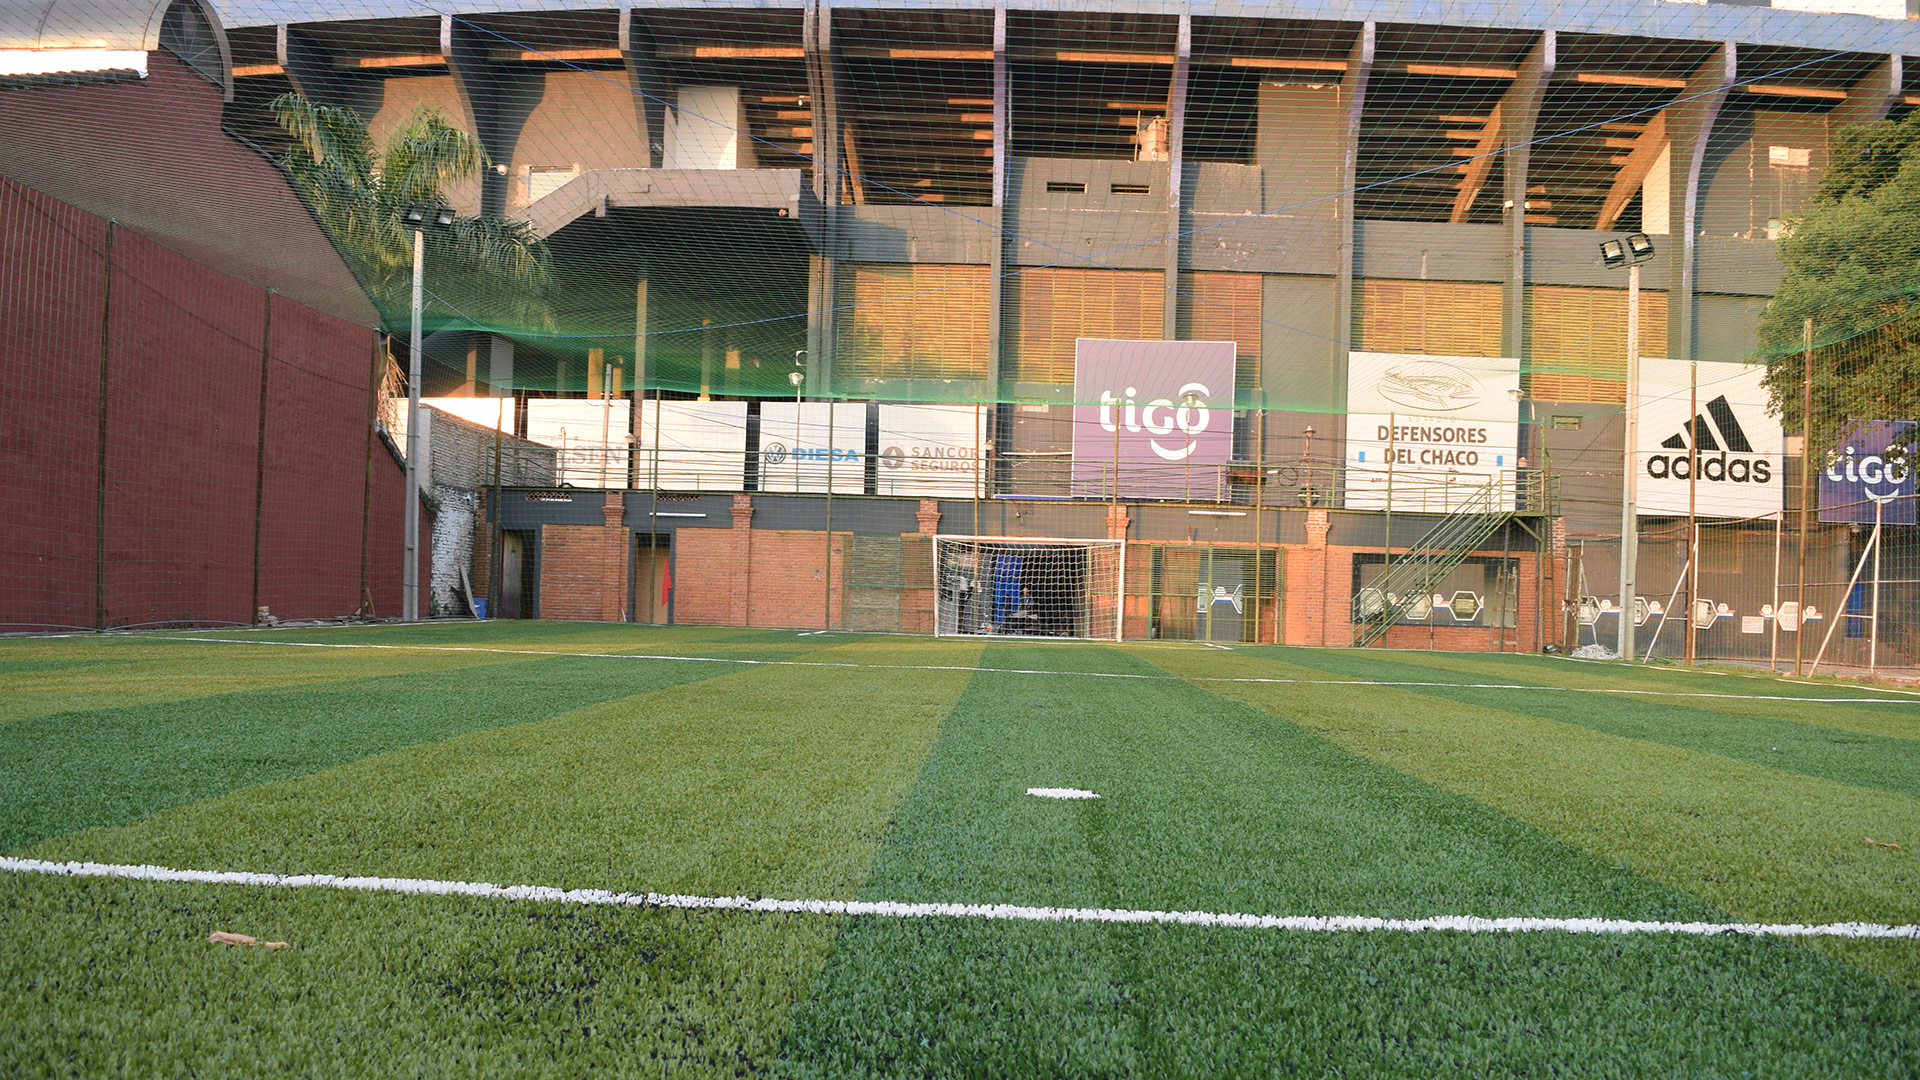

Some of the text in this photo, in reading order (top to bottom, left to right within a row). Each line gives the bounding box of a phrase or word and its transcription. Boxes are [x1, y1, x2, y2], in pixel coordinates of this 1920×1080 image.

[1100, 383, 1210, 460] tigo
[1377, 425, 1487, 443] DEFENSORES
[791, 447, 859, 462] DIESA
[911, 446, 977, 459] SANCOR
[1384, 448, 1478, 466] DEL CHACO
[911, 459, 978, 472] SEGUROS
[1647, 448, 1771, 483] adidas
